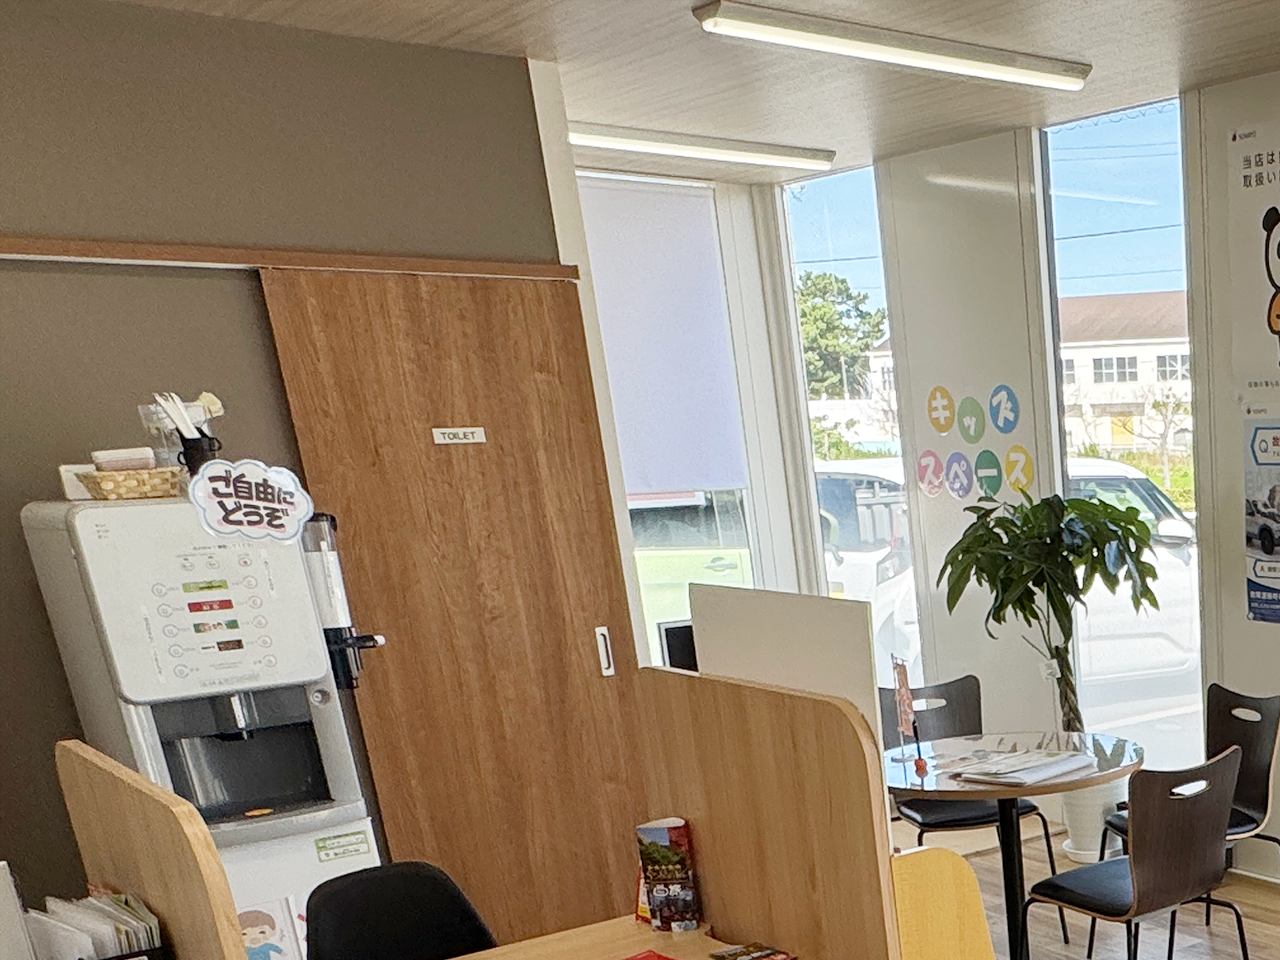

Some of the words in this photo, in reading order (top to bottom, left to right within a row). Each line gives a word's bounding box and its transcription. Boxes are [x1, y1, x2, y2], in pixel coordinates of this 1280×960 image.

[931, 389, 1016, 436] キッズ
[440, 431, 476, 440] TOILET
[1258, 439, 1269, 453] Q
[920, 452, 1030, 487] スペース
[208, 469, 296, 507] ご自由に
[220, 501, 290, 530] どうぞ
